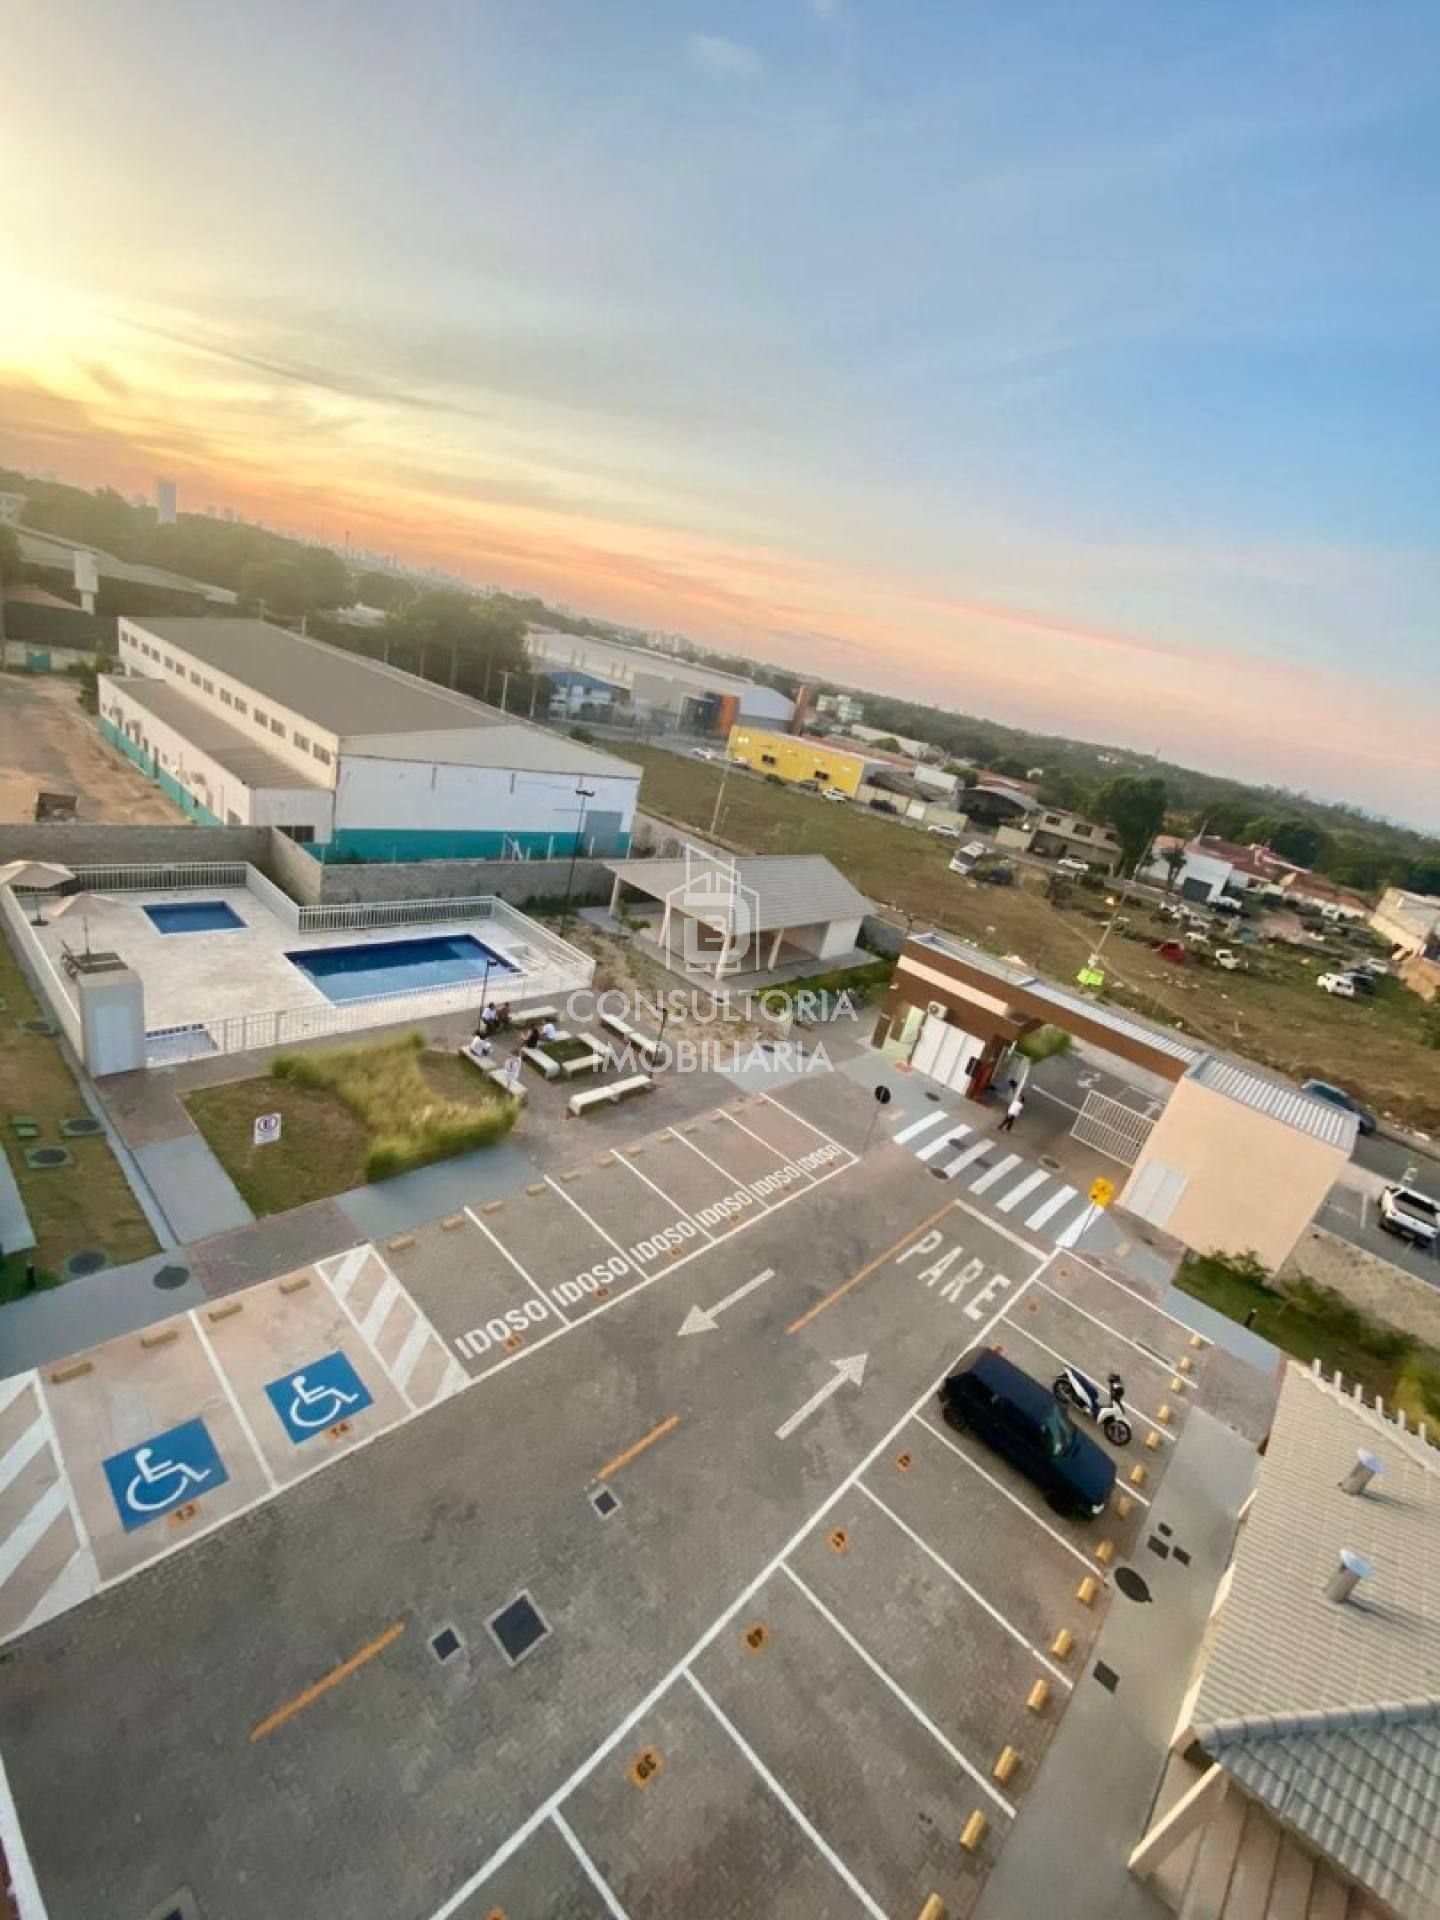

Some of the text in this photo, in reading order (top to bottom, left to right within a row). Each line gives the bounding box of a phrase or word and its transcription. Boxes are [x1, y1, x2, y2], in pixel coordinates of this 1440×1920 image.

[799, 1145, 844, 1171] IDOSO
[754, 1166, 799, 1196] IDOSO
[699, 1191, 752, 1228] IDOSO
[631, 1221, 696, 1263] IDOSO
[553, 1256, 629, 1307] IDOSO
[896, 1229, 1011, 1321] PARE
[454, 1298, 548, 1359] IDOSO
